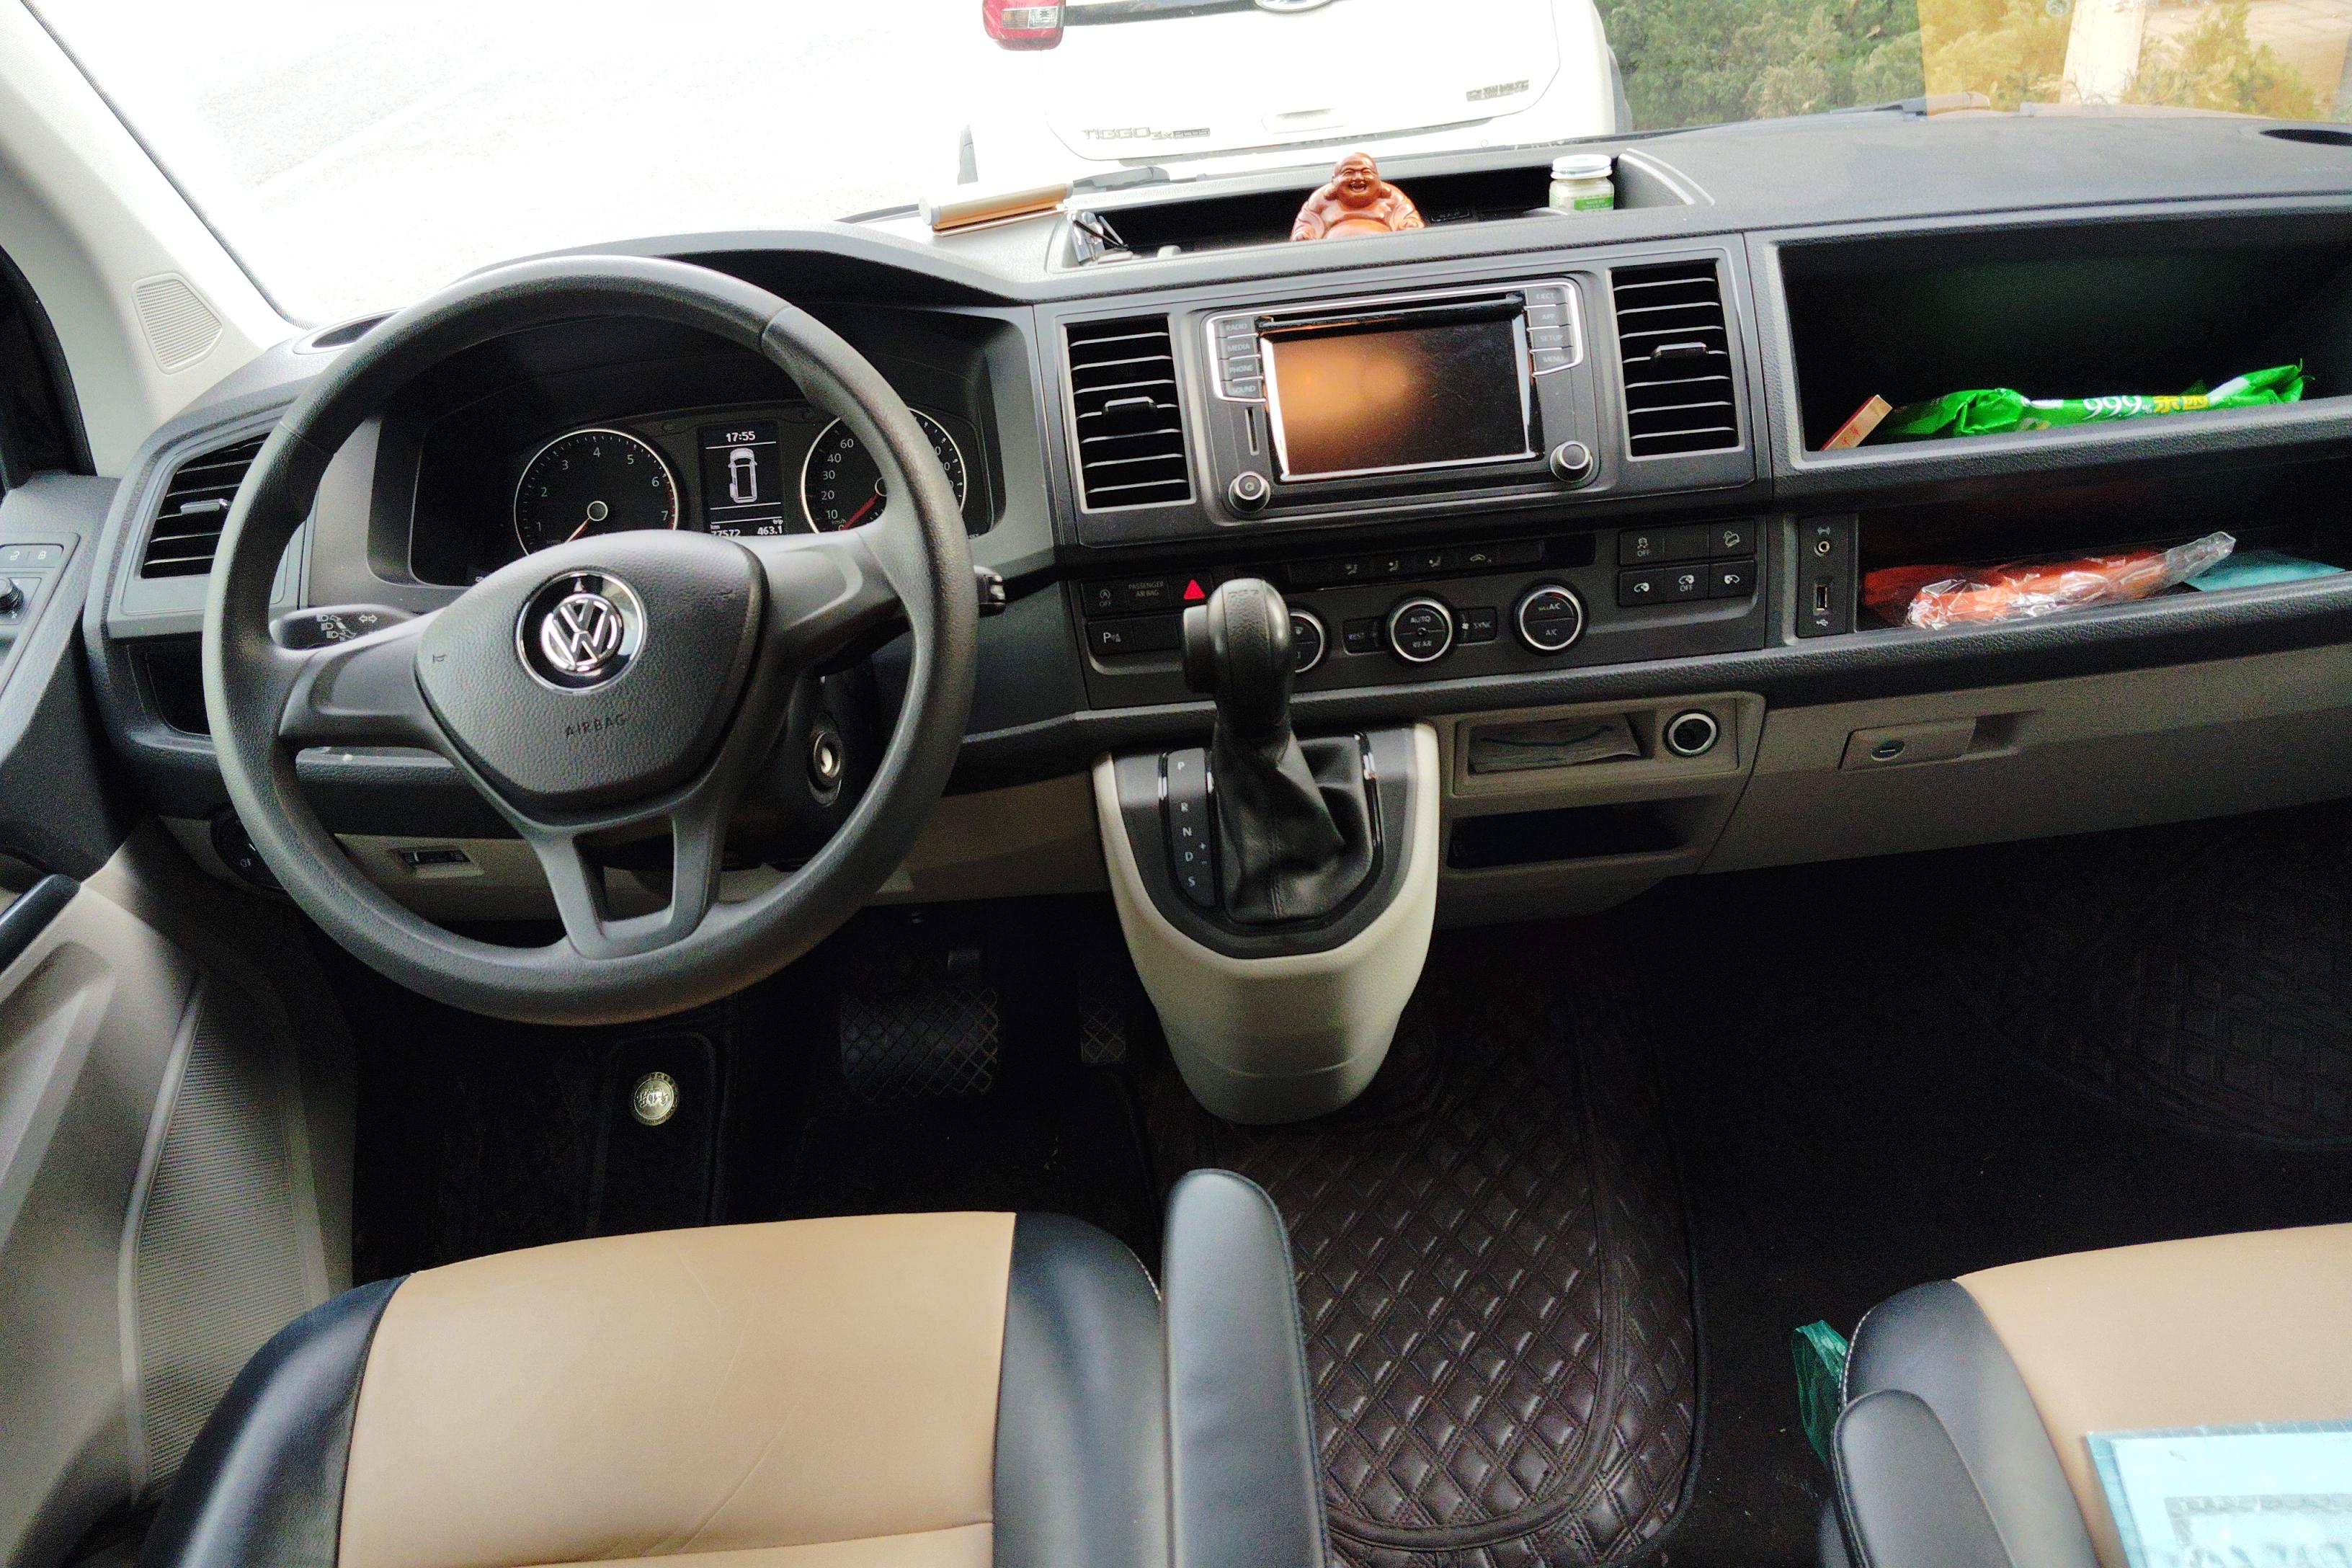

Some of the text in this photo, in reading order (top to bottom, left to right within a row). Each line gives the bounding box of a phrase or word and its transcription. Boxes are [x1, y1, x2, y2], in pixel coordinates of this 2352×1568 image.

[1081, 126, 1151, 141] TIGGO
[1226, 323, 1248, 331] RADIO
[1227, 343, 1251, 352] MEDIA
[1229, 364, 1254, 373] PHONE
[726, 431, 756, 442] 17:55
[839, 438, 854, 449] 60
[593, 447, 601, 458] 4
[827, 453, 842, 463] 40
[562, 460, 569, 470] 3
[627, 454, 634, 465] 5
[822, 470, 836, 480] 30
[651, 476, 659, 487] 6
[540, 487, 548, 497] 2
[821, 490, 835, 501] 20
[661, 510, 669, 521] 7
[826, 509, 838, 520] 10
[536, 522, 541, 532] 1
[757, 525, 783, 535] 463.1
[1410, 615, 1431, 624] AUTO
[564, 713, 626, 739] AIRBAG
[1177, 761, 1185, 770] P
[1180, 802, 1188, 813] R
[1182, 827, 1193, 837] N
[1185, 851, 1194, 863] D
[1188, 876, 1195, 888] S
